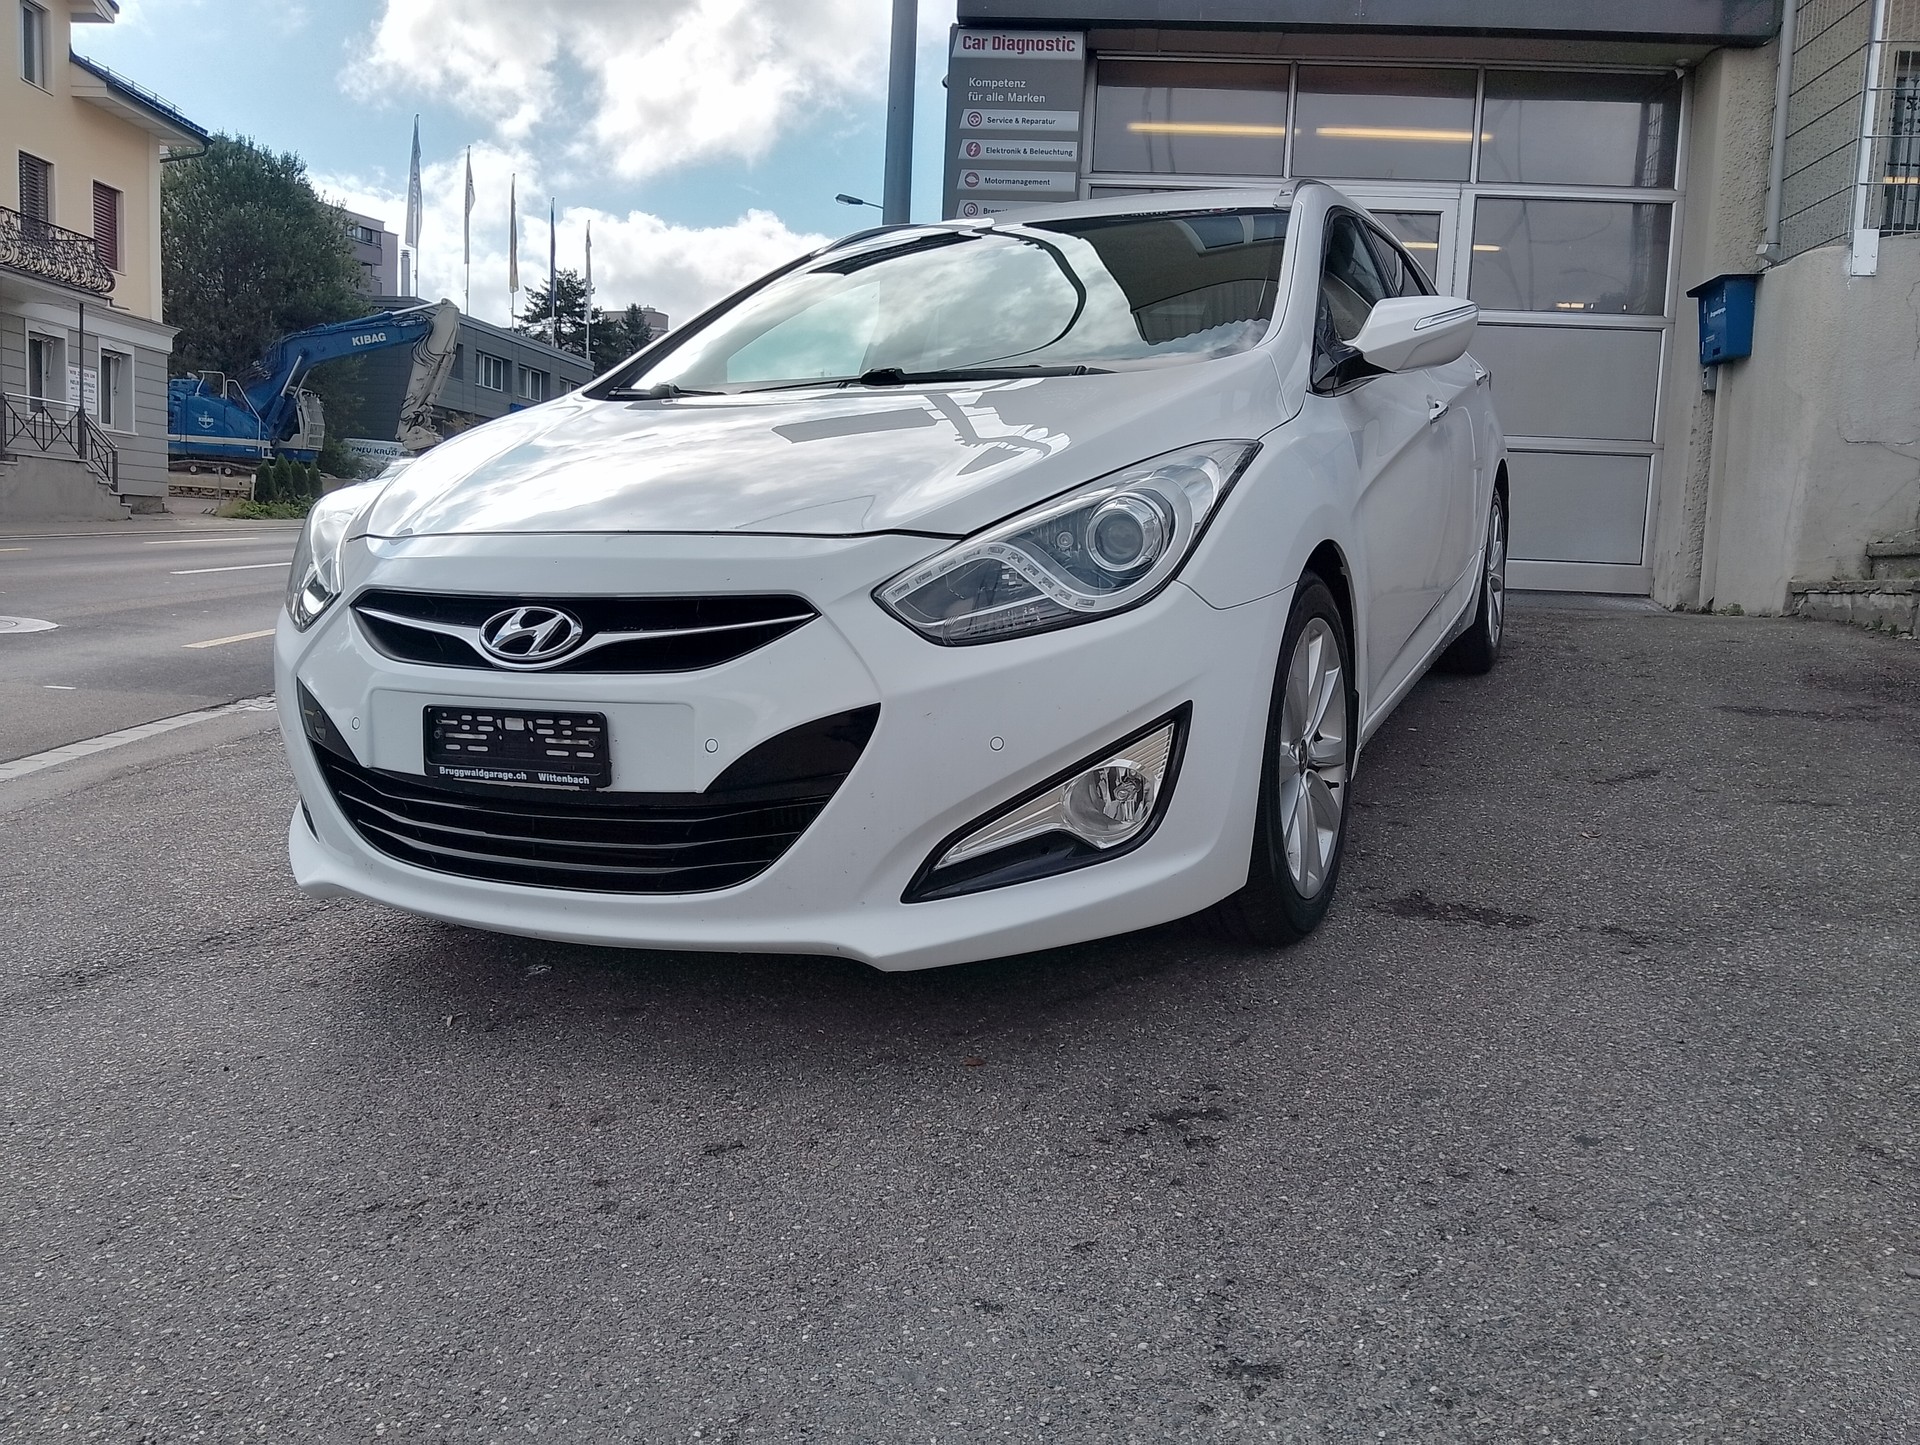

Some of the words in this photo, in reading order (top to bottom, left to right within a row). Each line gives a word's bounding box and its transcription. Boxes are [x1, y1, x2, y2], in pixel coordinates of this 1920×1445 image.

[963, 35, 988, 50] Car
[992, 35, 1076, 54] Diagnostic
[969, 77, 1026, 89] Kompetenz
[968, 92, 983, 101] für
[986, 93, 1004, 102] alle
[1007, 93, 1046, 103] Marken
[987, 116, 1014, 124] Service
[1021, 117, 1056, 126] Reparatur
[986, 147, 1021, 155] Elektronik
[1029, 148, 1073, 157] Beleuchtung
[984, 177, 1050, 187] Motormanagement
[352, 332, 387, 346] KIBAG
[439, 766, 527, 781] Bruggwaldgarage.ch
[538, 773, 590, 785] Wittenbach
